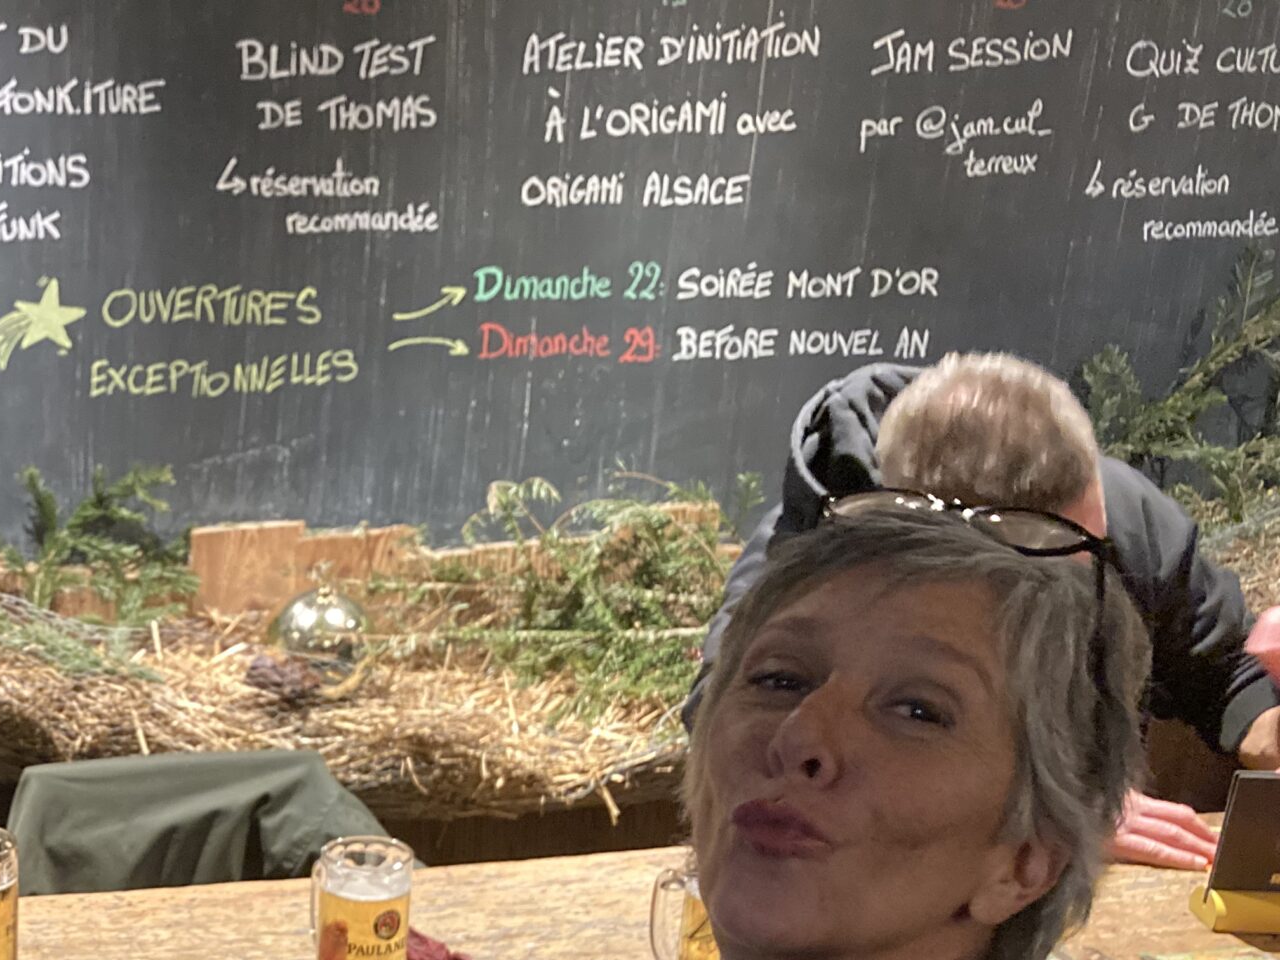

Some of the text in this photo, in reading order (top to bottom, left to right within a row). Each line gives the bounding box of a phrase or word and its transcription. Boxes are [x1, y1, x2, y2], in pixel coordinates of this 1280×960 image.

[19, 24, 69, 54] DU
[236, 35, 436, 80] BLIND TEST
[522, 32, 645, 75] ATELIER
[871, 28, 1073, 75] JAM SESSION
[1126, 38, 1204, 78] QUIZ
[256, 95, 437, 131] DE THOMAS
[544, 86, 797, 143] À L'ORIGAMI avec
[1129, 103, 1155, 132] G
[1177, 101, 1219, 130] DE
[859, 115, 903, 153] par
[250, 156, 380, 198] réservation
[964, 148, 1038, 177] terreux
[1111, 163, 1230, 199] réservation
[521, 170, 751, 208] ORIGAMI ALSACE
[285, 202, 440, 234] recommandée
[1142, 208, 1279, 242] recommandée
[474, 265, 613, 300] Dimanche
[676, 262, 773, 300] SOIRÉE
[786, 266, 861, 299] MONT
[870, 268, 940, 298] D'OR
[102, 284, 322, 328] OUVERTURES
[478, 322, 611, 362] Dimanche
[672, 325, 779, 362] BEFORE
[789, 329, 884, 358] NOUVEL
[893, 328, 932, 358] AN
[89, 349, 359, 398] EXCEPTIONNELLES
